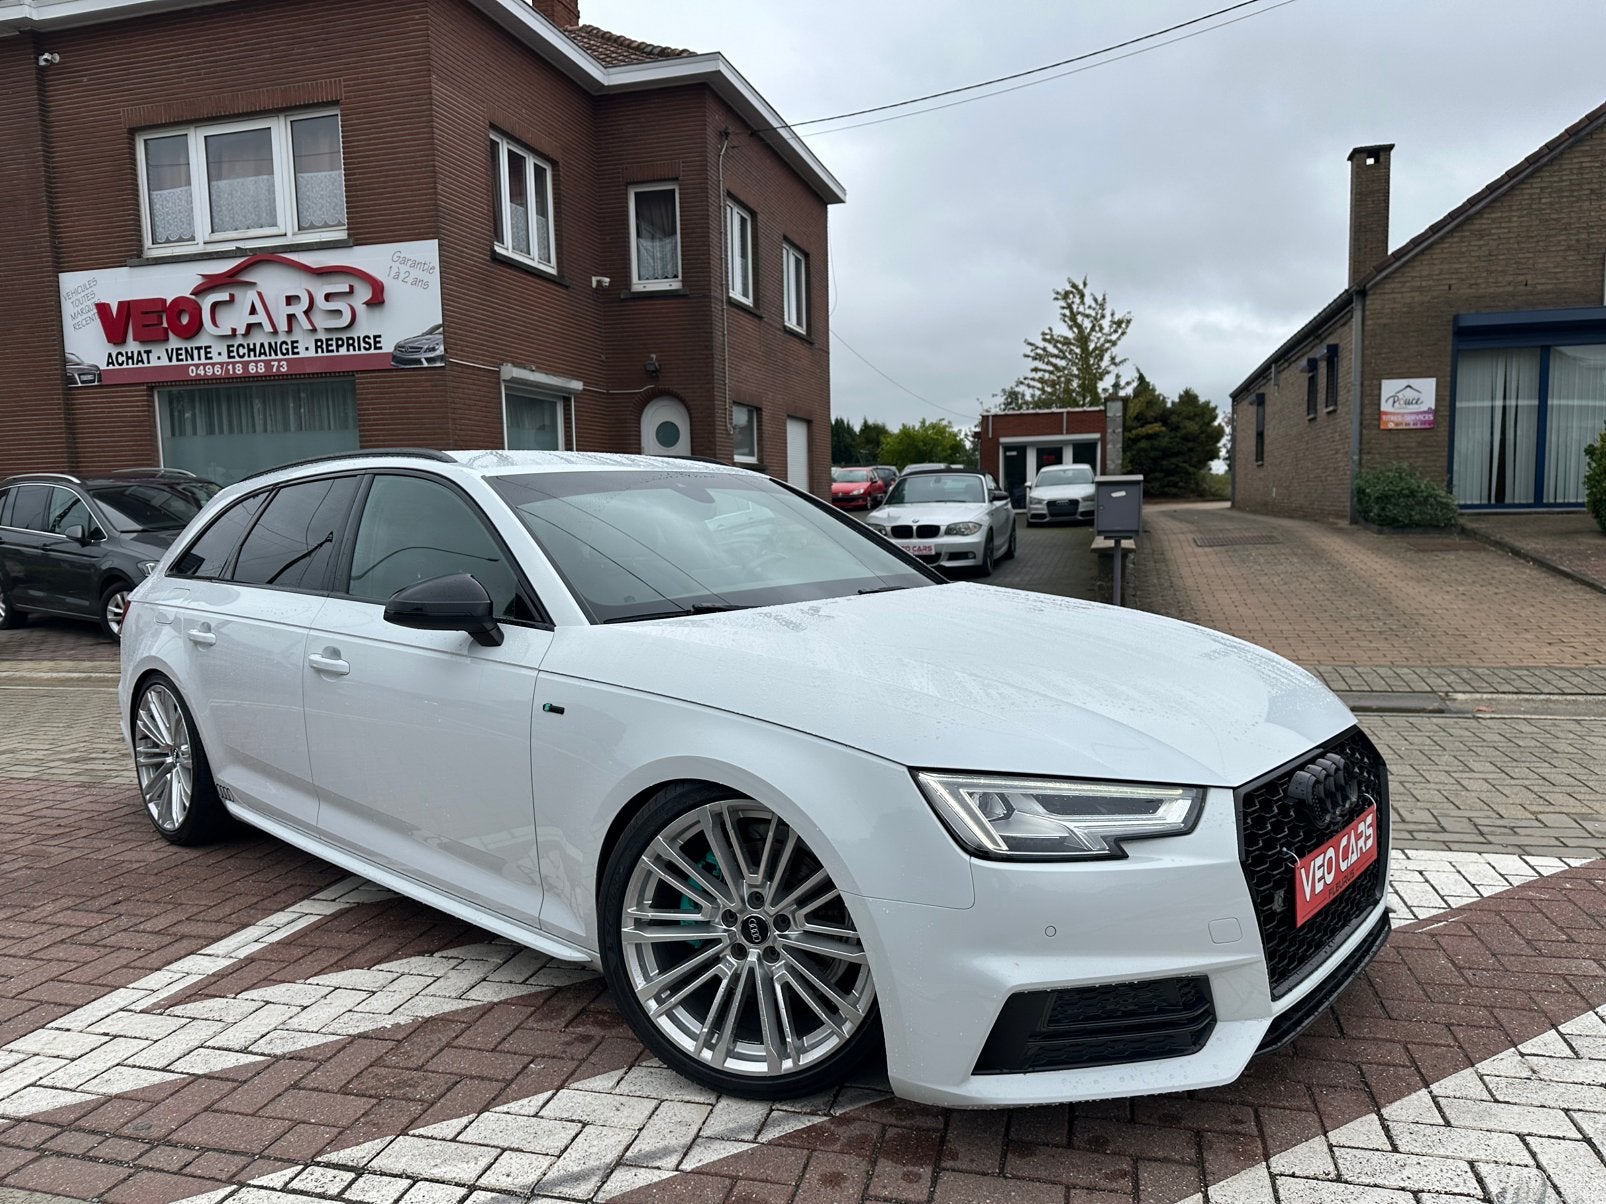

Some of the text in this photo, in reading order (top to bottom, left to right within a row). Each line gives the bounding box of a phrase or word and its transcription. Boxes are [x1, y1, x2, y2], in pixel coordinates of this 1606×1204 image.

[391, 250, 436, 275] Garantie
[62, 277, 98, 302] VEHICULES
[387, 265, 392, 277] 1
[401, 270, 411, 284] 2
[410, 277, 430, 290] ans
[71, 290, 96, 309] TOUTES
[106, 335, 383, 367] ACHAT VENTE ECHANGE REPRISE
[188, 361, 288, 377] 0496/18 68 73
[1300, 813, 1374, 902] VEO CARS
